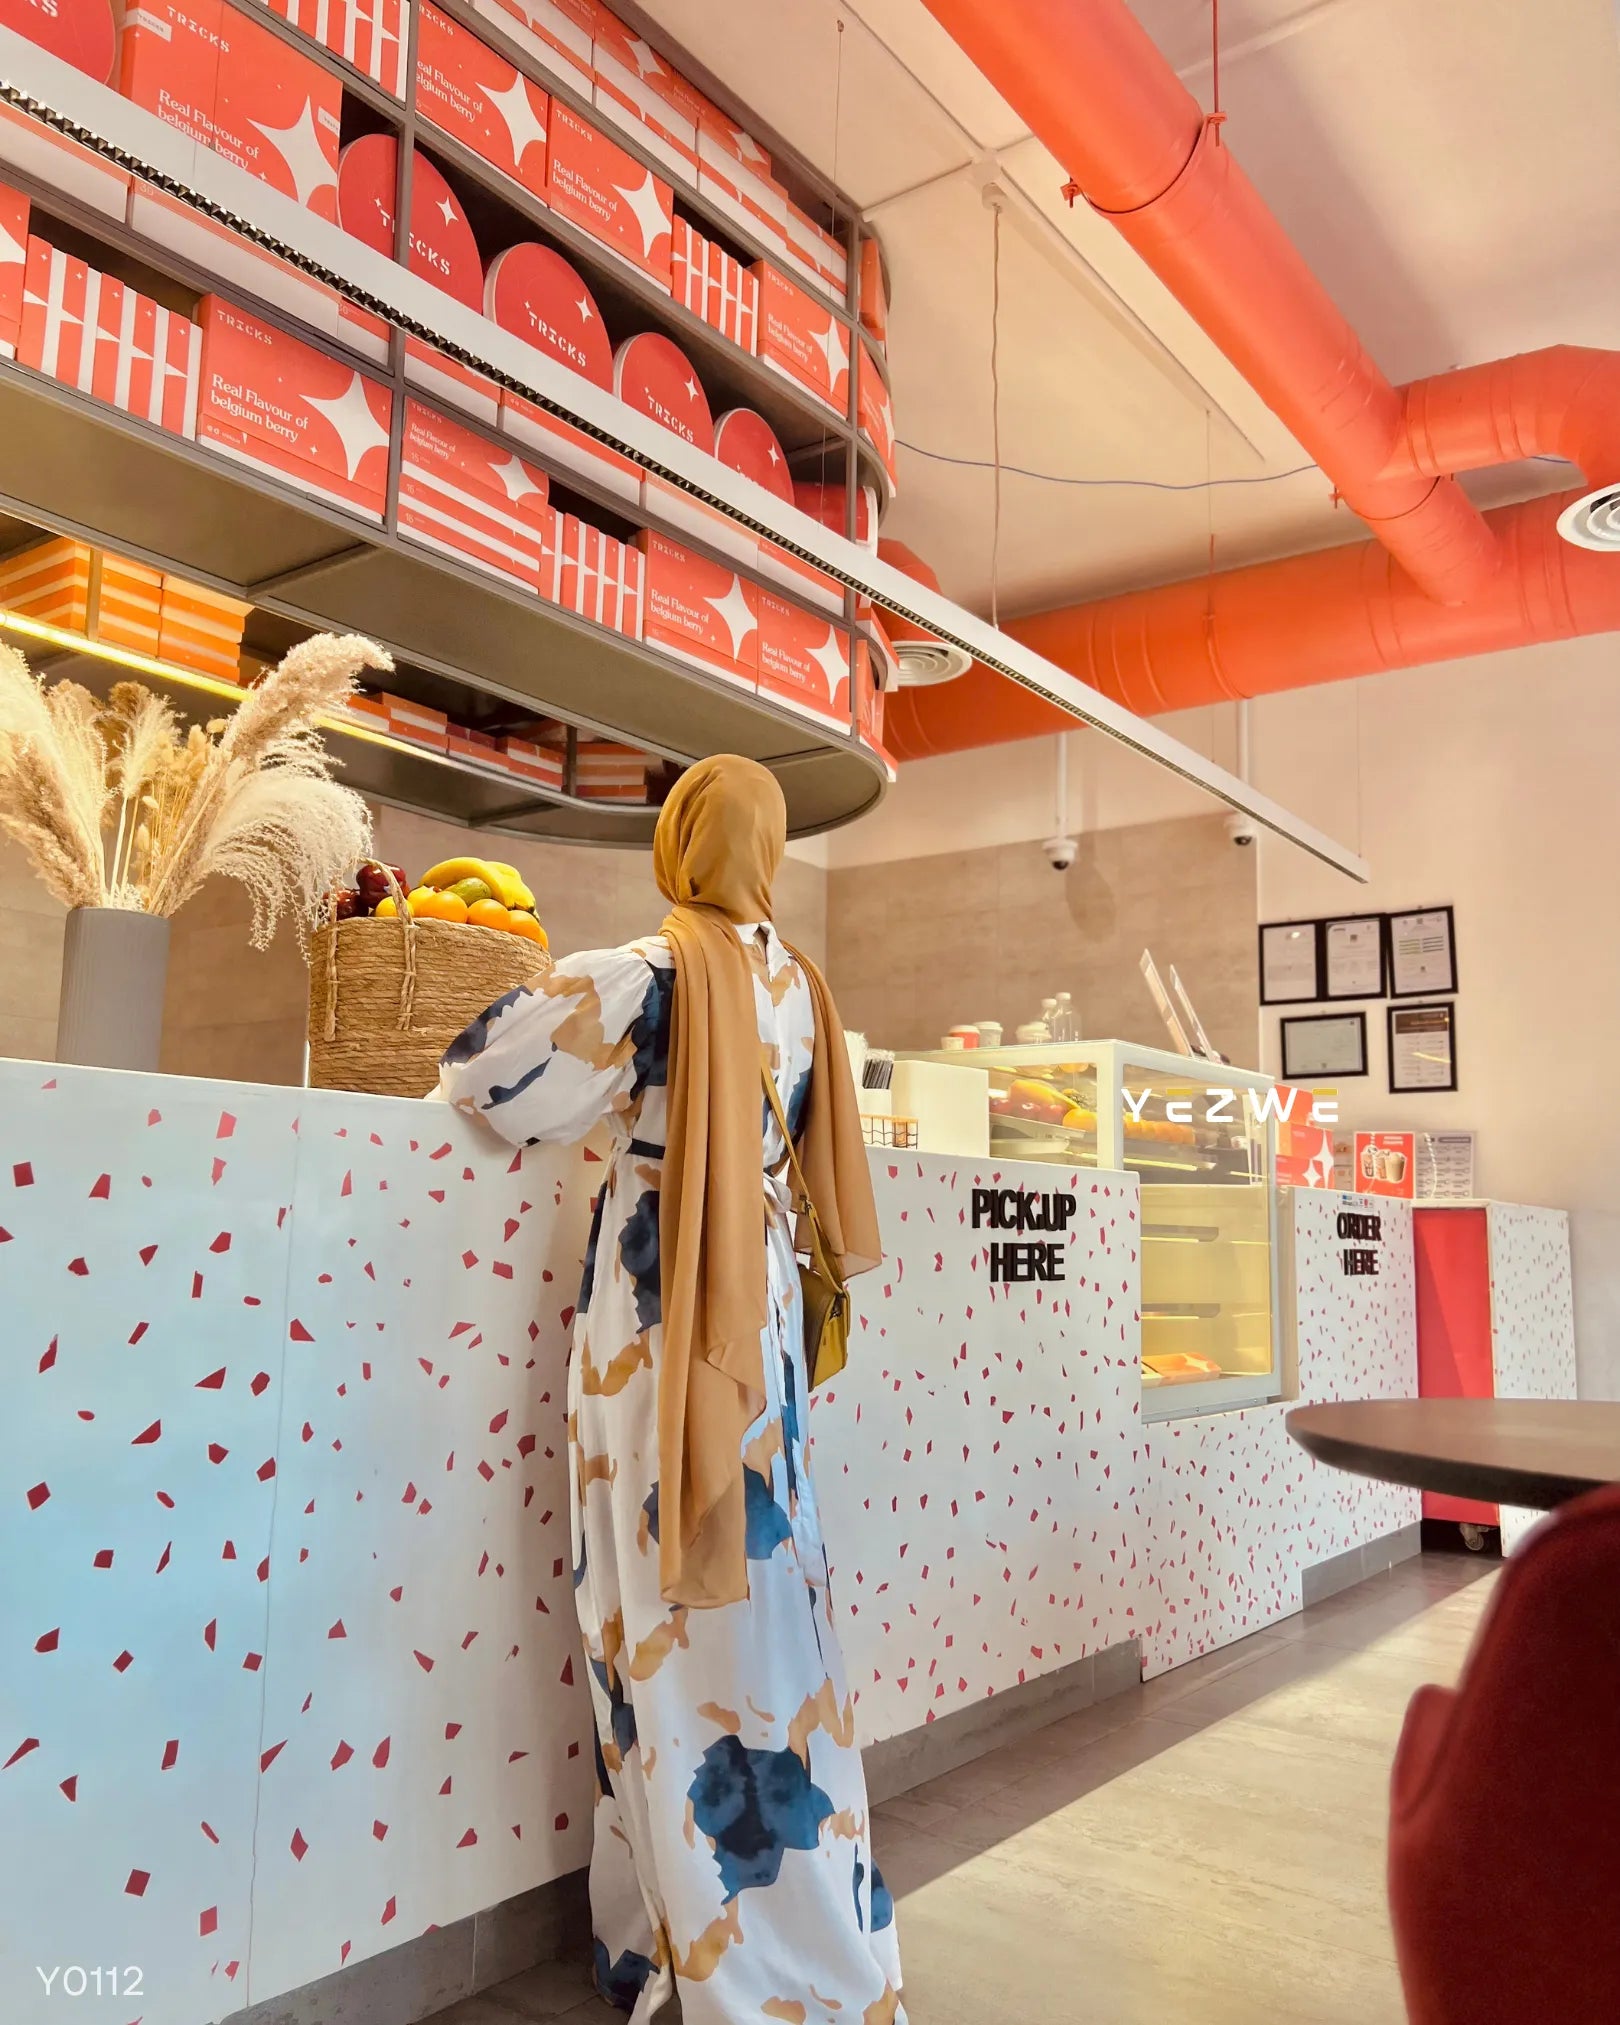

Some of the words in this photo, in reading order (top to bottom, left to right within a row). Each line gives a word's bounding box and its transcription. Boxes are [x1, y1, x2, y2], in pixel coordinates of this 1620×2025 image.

[167, 5, 230, 52] TRICKS
[418, 4, 454, 36] RICKS
[416, 74, 448, 102] elgium
[450, 95, 475, 122] berry
[417, 61, 432, 76] eal
[434, 70, 471, 104] Flavour
[473, 102, 483, 113] of
[160, 89, 191, 118] Real
[194, 109, 243, 149] Flavour
[246, 147, 260, 159] of
[556, 109, 593, 142] TRICKS
[215, 138, 249, 170] berry
[553, 159, 573, 181] Real
[575, 174, 607, 204] Flavour
[608, 201, 618, 213] of
[553, 171, 587, 203] belgium
[588, 197, 611, 222] berry
[217, 309, 272, 345] TRICKS
[529, 311, 587, 367] TRICKS
[211, 389, 263, 425] belgium
[265, 415, 298, 443] berry
[212, 373, 242, 399] Real
[245, 389, 292, 422] Flavour
[295, 416, 308, 430] of
[648, 395, 694, 443] TRICKS
[411, 423, 426, 437] Real
[650, 601, 682, 624] belgium
[683, 615, 704, 636] berry
[651, 589, 669, 605] Real
[671, 597, 699, 619] Flavour
[701, 612, 710, 624] of
[1337, 1212, 1382, 1241] ORDER
[990, 1242, 1066, 1283] HERE
[1343, 1249, 1379, 1276] HERE
